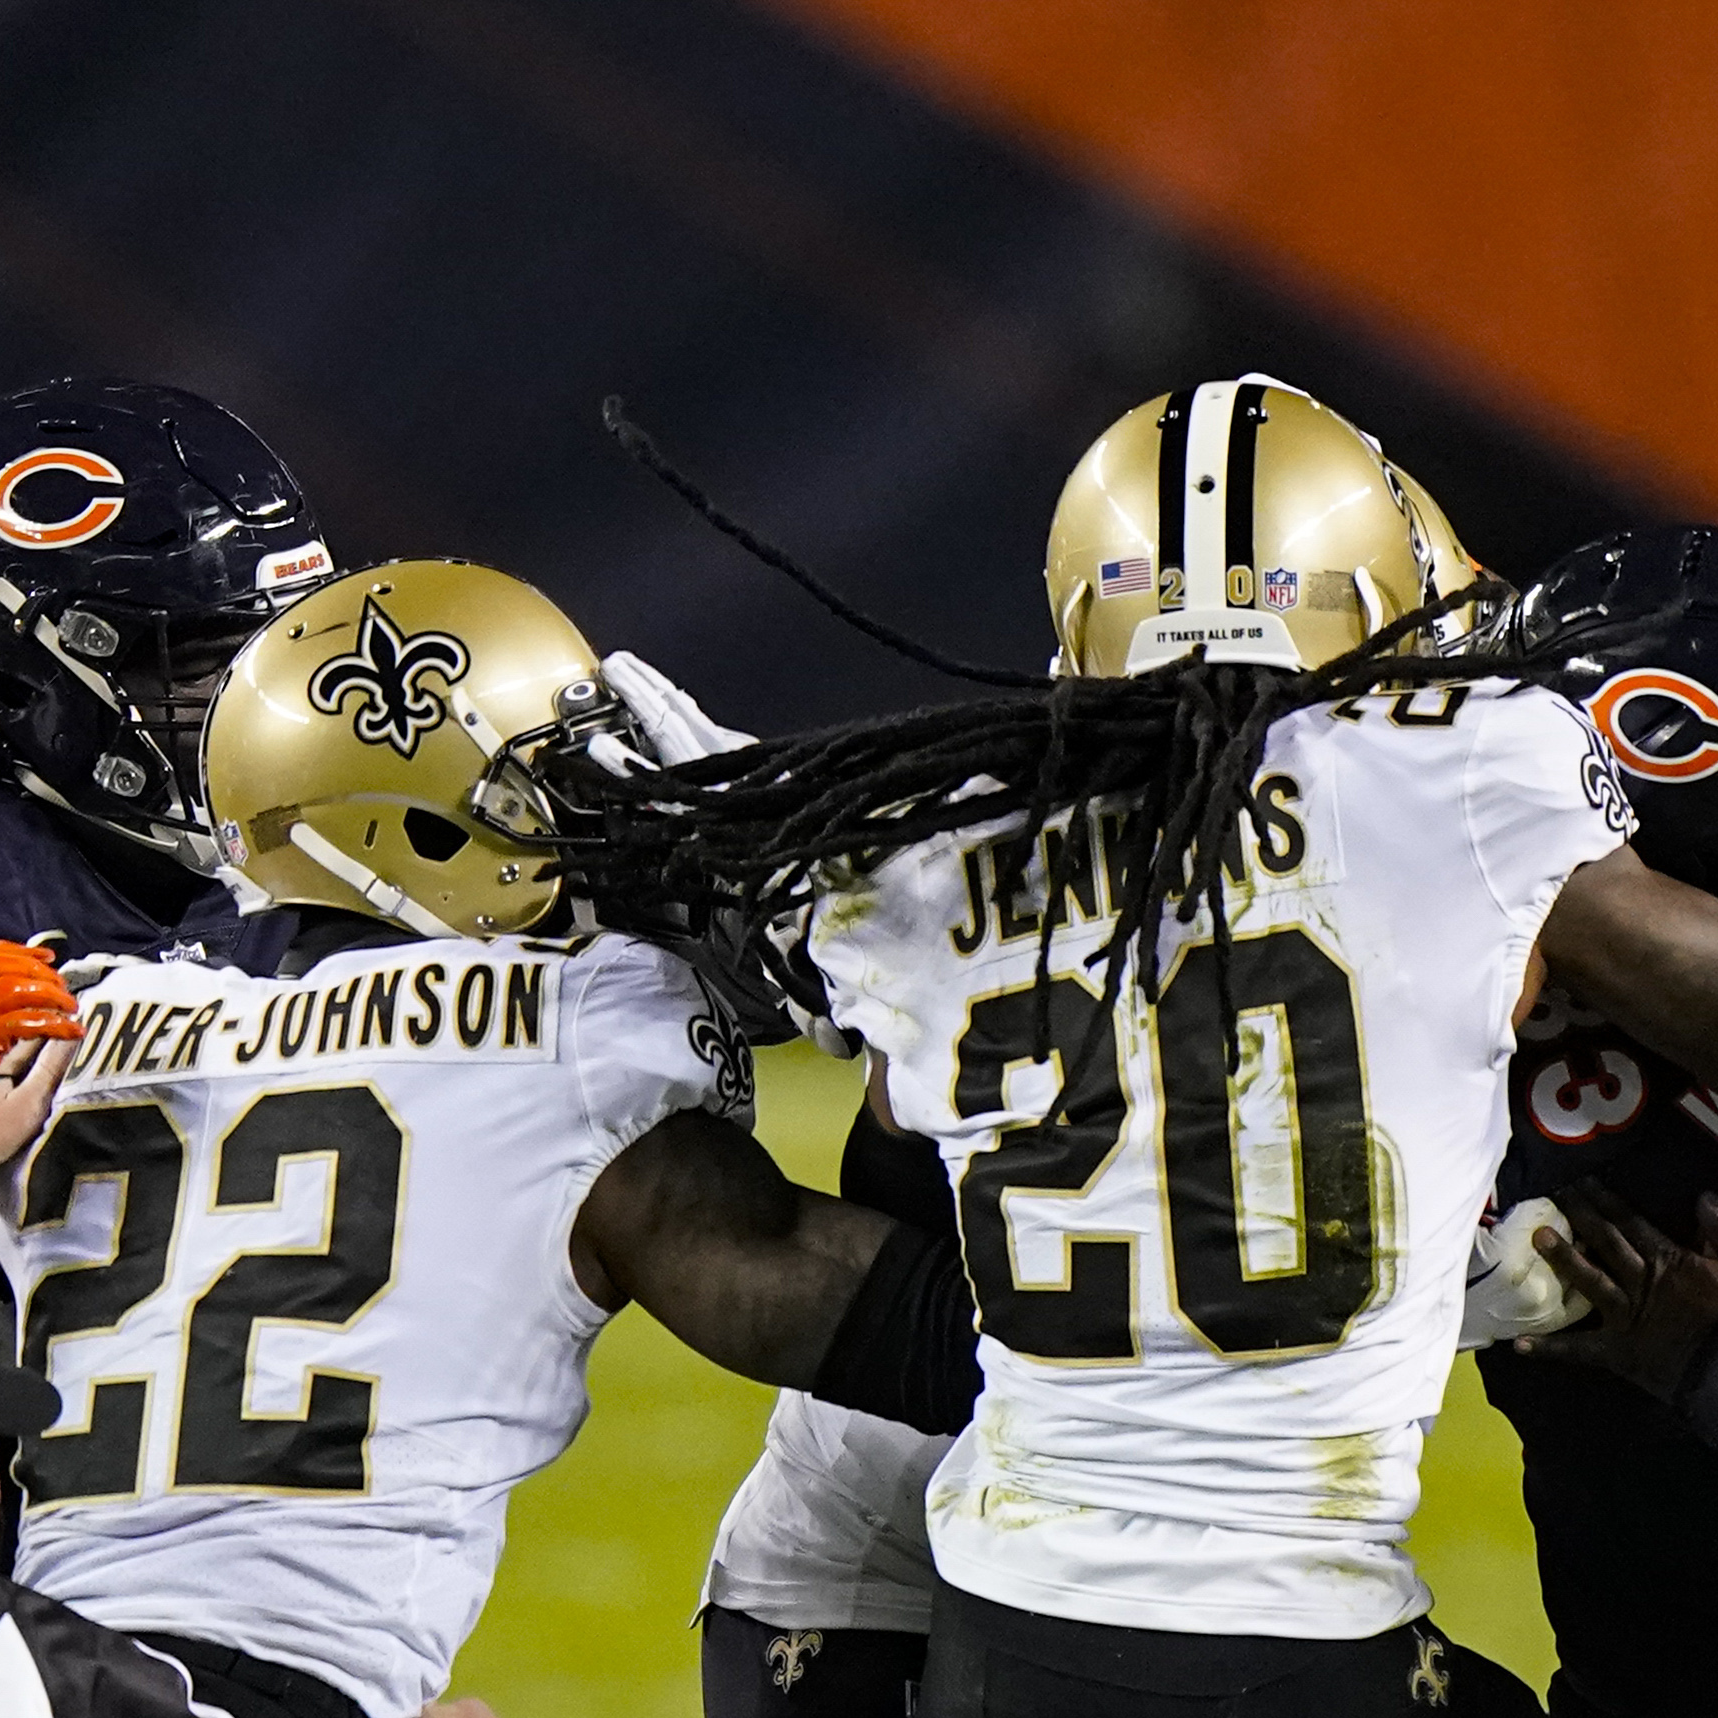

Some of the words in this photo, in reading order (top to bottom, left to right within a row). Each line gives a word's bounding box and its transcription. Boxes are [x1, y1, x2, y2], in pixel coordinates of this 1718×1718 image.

[274, 553, 325, 579] BEARS
[1267, 585, 1294, 605] NFL
[1156, 632, 1167, 643] IT
[1170, 630, 1205, 642] TAKES
[1207, 629, 1229, 641] ALL
[1231, 628, 1245, 639] OF
[1247, 627, 1264, 638] US
[65, 962, 548, 1082] DNER-JOHNSON
[950, 920, 1381, 1367] 20
[11, 1079, 412, 1517] 22
